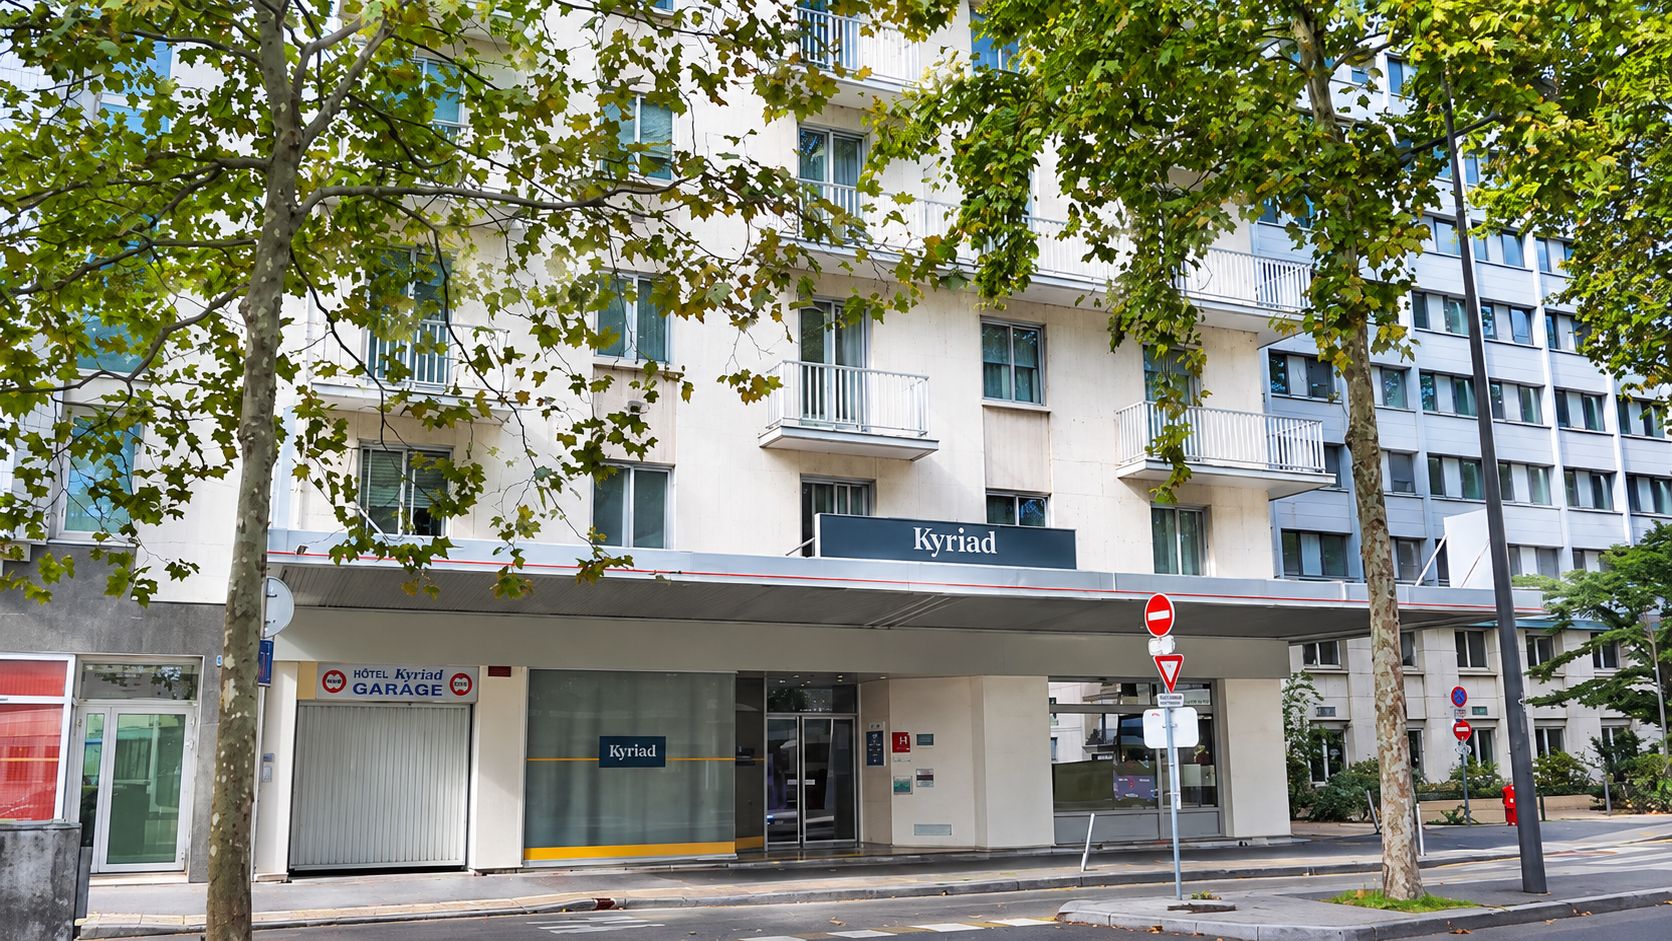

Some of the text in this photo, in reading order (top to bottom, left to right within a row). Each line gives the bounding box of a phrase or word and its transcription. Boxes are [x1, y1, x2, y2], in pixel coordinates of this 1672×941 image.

[913, 527, 997, 557] Kyriad
[354, 668, 443, 683] HÔTEL Kyriad
[353, 683, 443, 696] GARAGE
[609, 743, 656, 761] Kyriad
